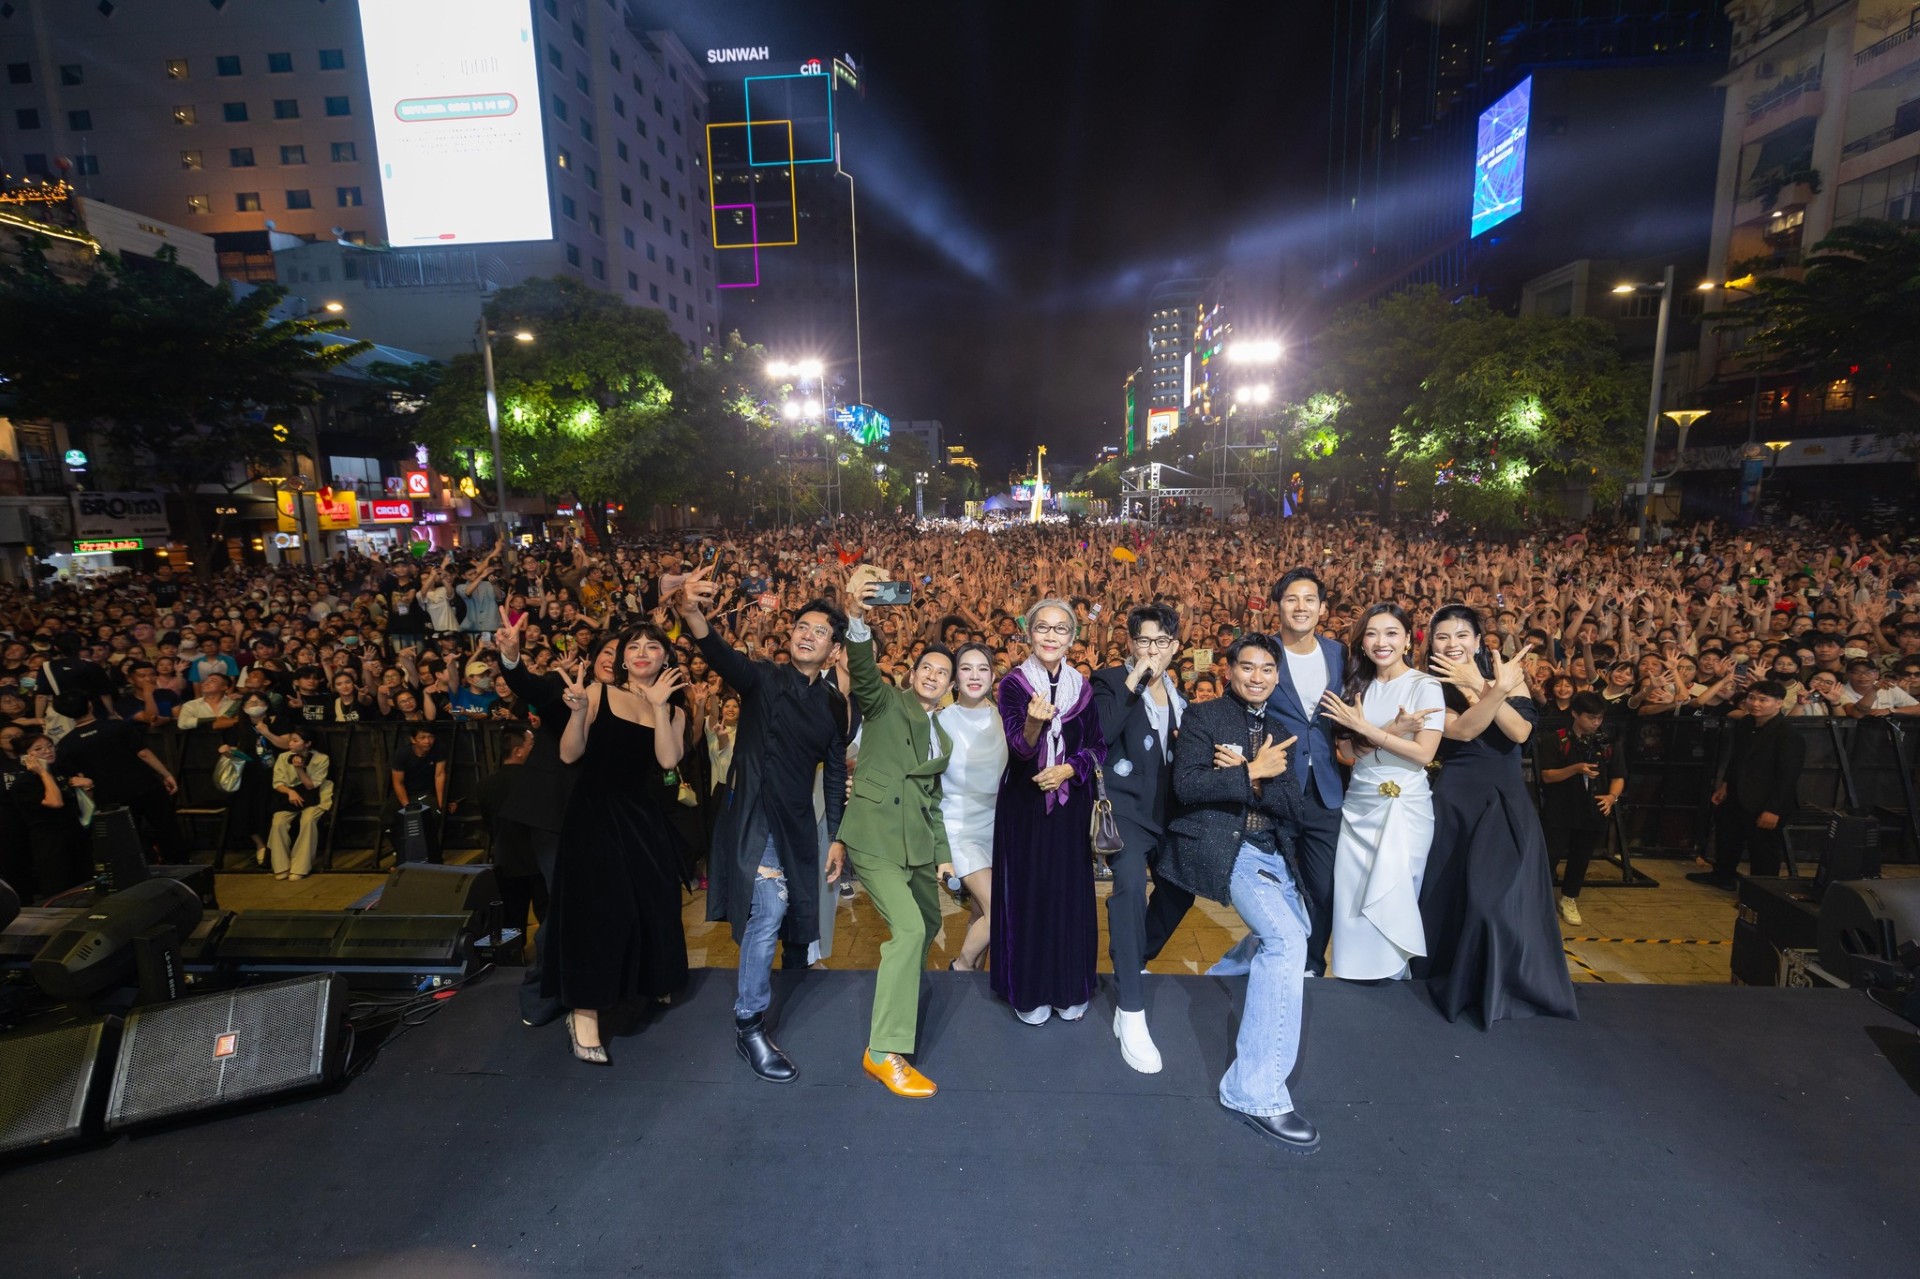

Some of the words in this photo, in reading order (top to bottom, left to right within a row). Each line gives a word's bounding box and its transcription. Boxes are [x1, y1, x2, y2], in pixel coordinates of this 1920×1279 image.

[707, 46, 769, 63] SUNWAH
[800, 61, 821, 75] citi
[412, 476, 427, 491] K
[375, 505, 400, 515] CIRCLE
